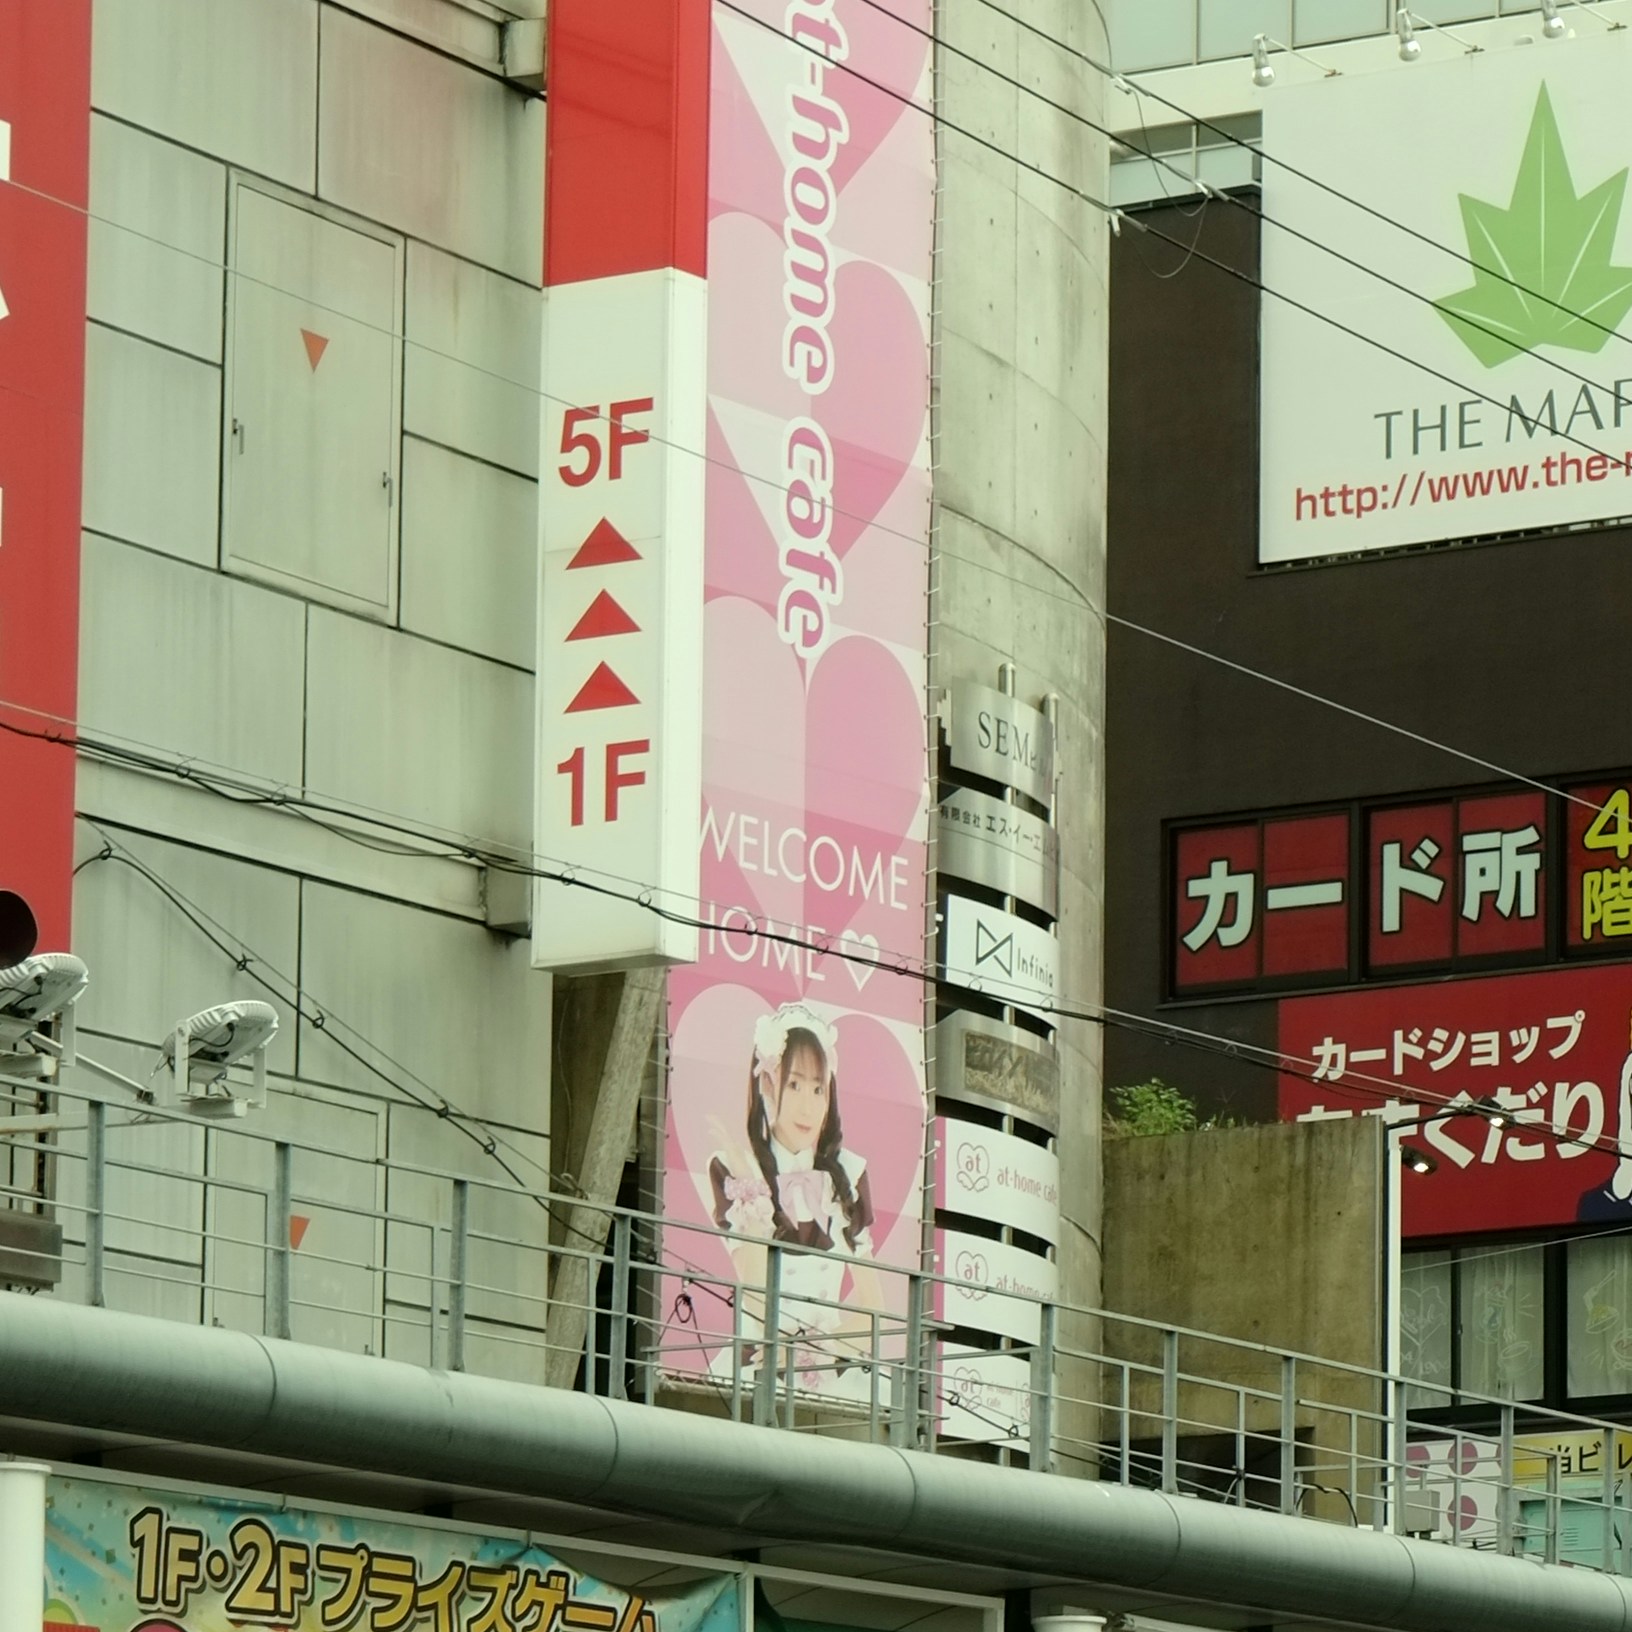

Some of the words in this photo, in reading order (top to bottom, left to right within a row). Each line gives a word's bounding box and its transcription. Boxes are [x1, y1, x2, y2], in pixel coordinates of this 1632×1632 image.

[558, 397, 654, 489] 5F
[1374, 400, 1483, 460] THE
[783, 420, 840, 650] cafe
[557, 739, 650, 827] 1F
[701, 811, 909, 911] WELCOME
[1182, 825, 1542, 953] カード所
[1311, 1010, 1586, 1084] カードショップ
